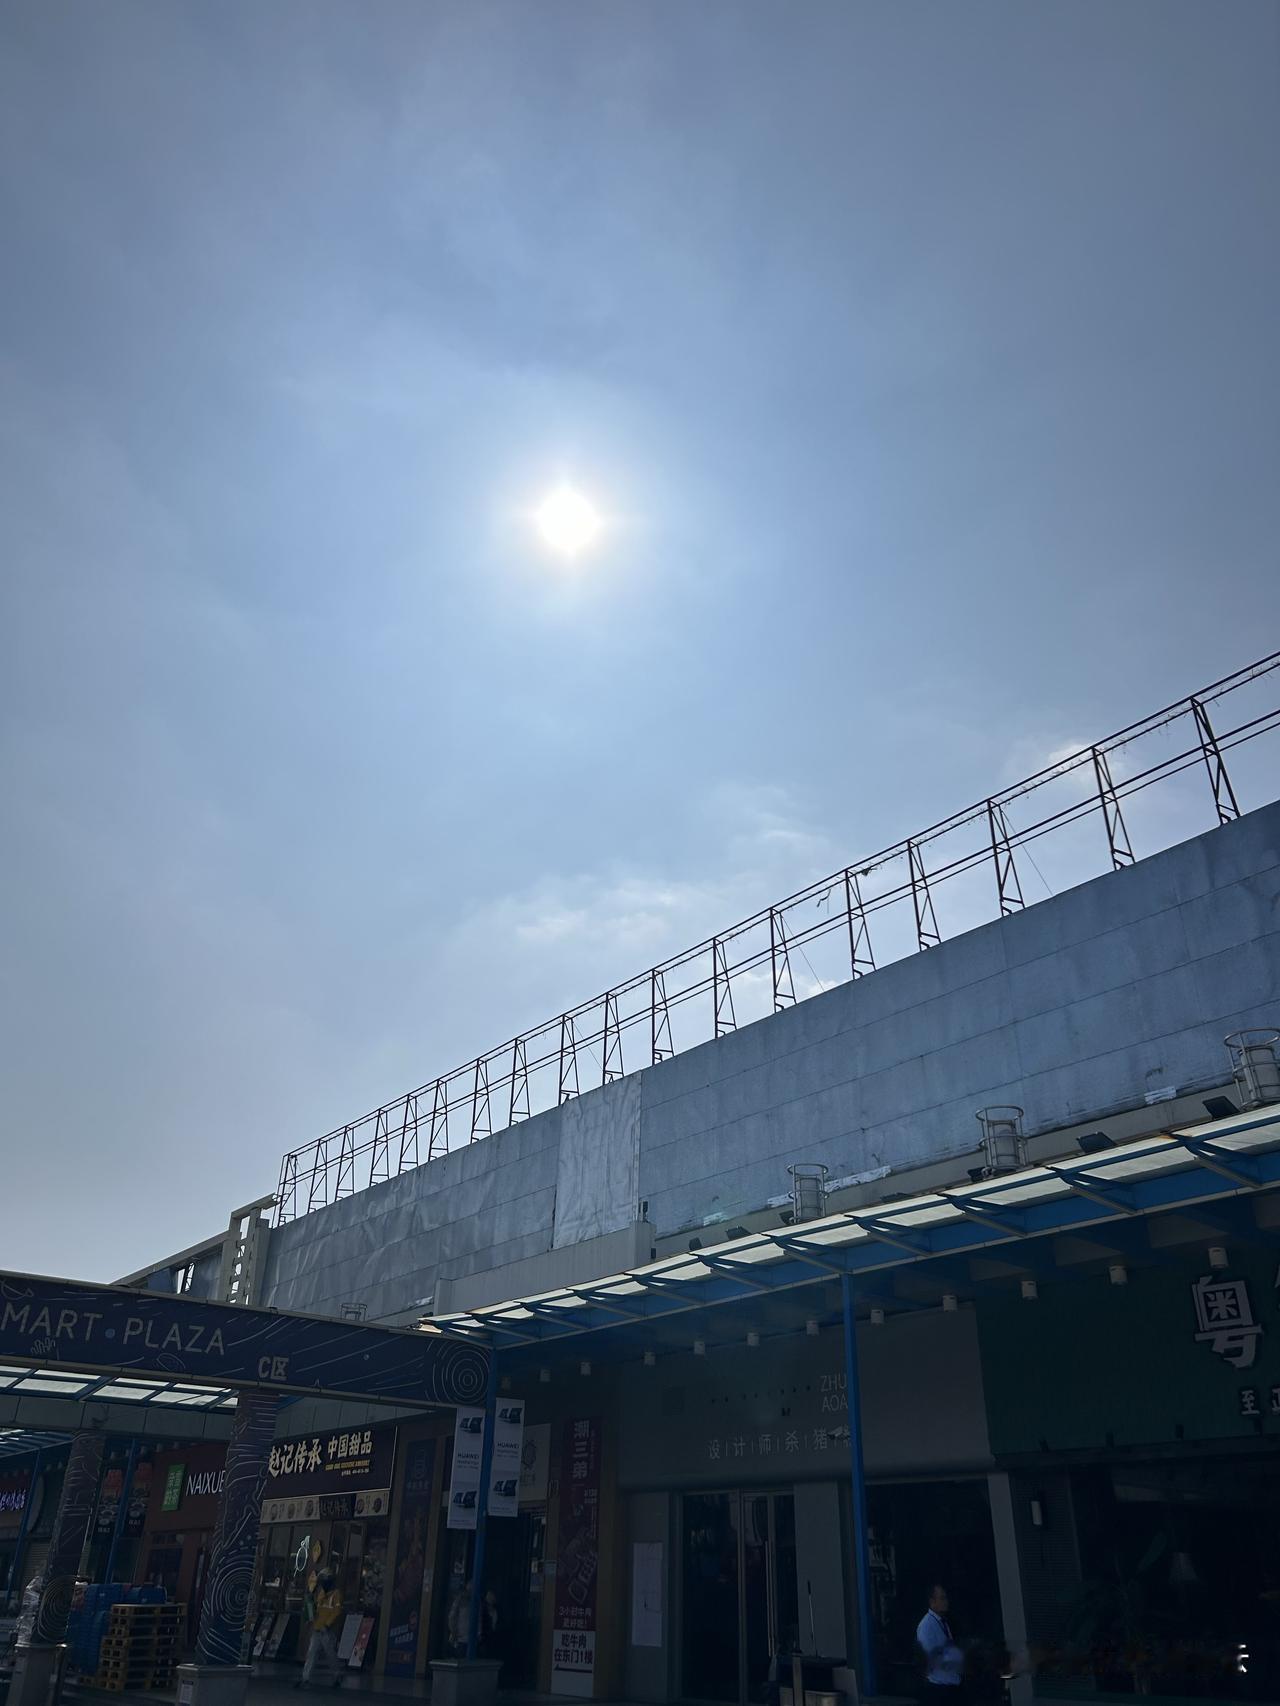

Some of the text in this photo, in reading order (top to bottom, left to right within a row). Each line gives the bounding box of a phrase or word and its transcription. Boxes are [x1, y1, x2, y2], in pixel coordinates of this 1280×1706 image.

[1, 1302, 225, 1356] MART PLAZA
[1191, 1265, 1280, 1368] 粤
[257, 1356, 290, 1381] C区
[268, 1430, 372, 1478] 赵记传承 中国甜品
[457, 1452, 480, 1460] HUAWEI
[561, 1633, 586, 1648] 吃牛肉
[554, 1648, 593, 1665] 在东门1楼
